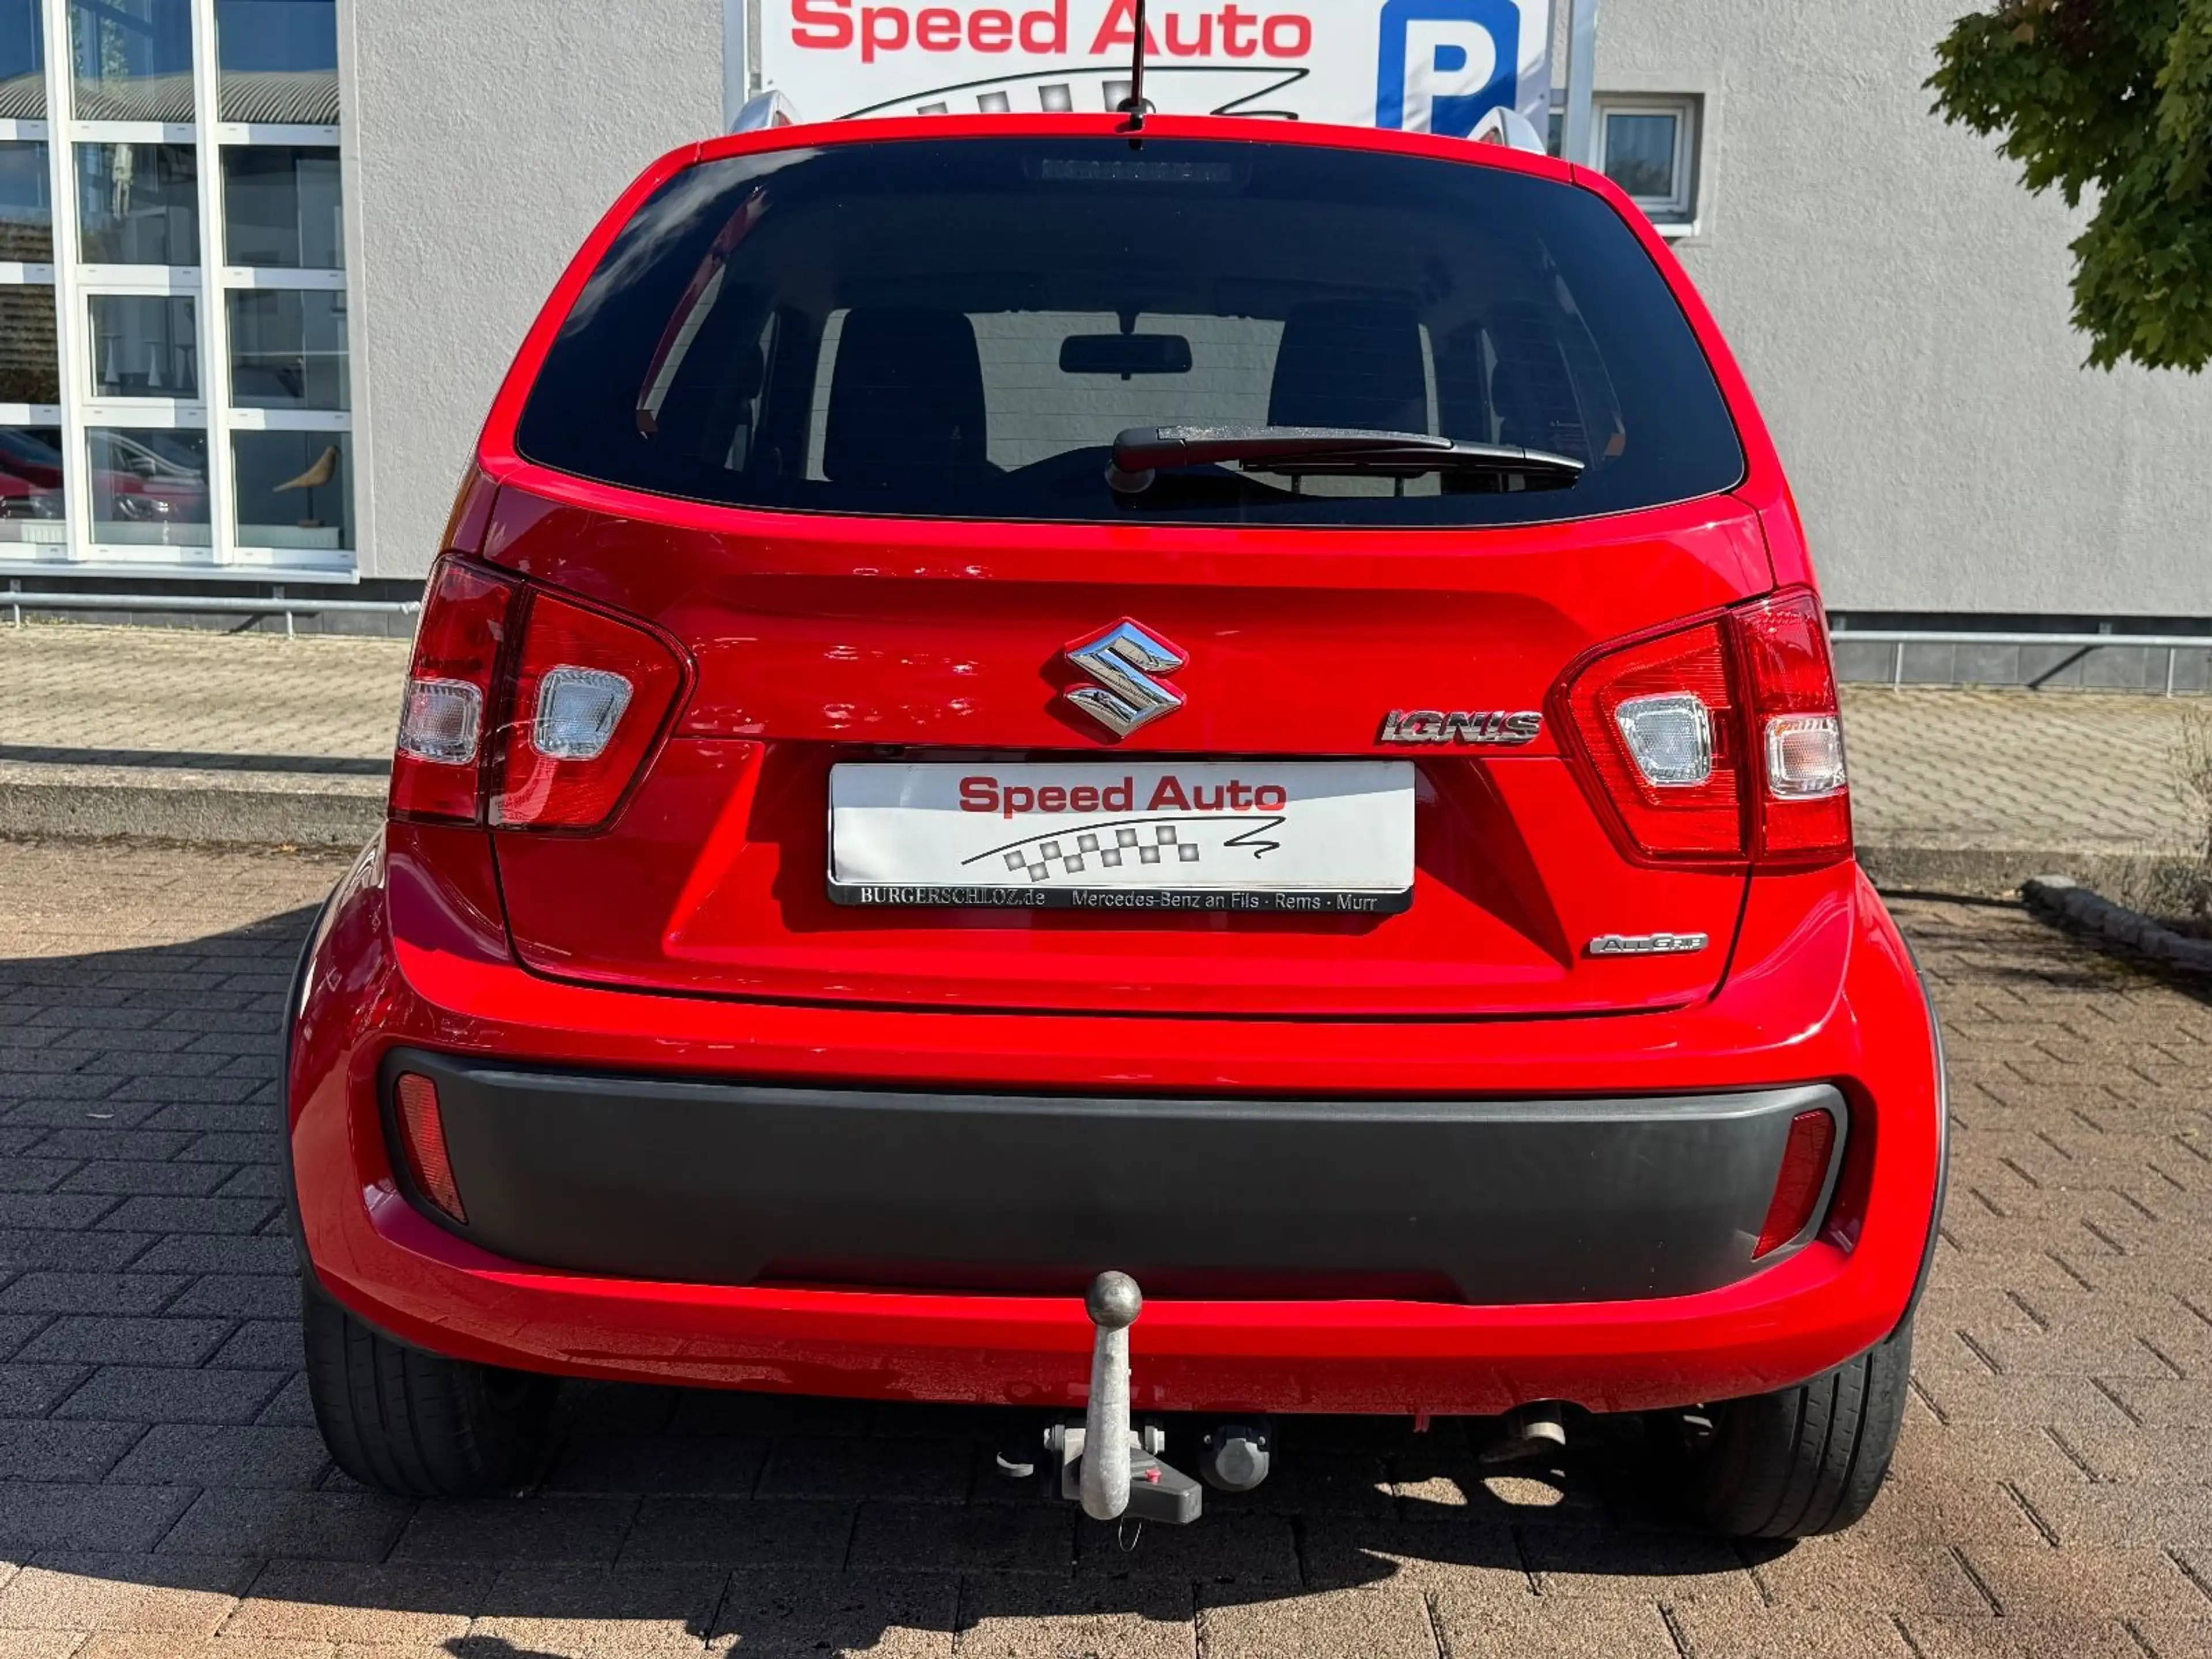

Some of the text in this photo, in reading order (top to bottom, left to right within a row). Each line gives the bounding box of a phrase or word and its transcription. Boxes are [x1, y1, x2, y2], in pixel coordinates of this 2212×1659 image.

[791, 0, 1313, 63] Speed Auto
[1402, 20, 1497, 134] P
[1381, 709, 1544, 744] IGNIS
[959, 775, 1286, 819] Speed Auto
[861, 887, 1377, 911] BURGERSCHLOZ.de Mercedes-Benz an Fils Rems Murr
